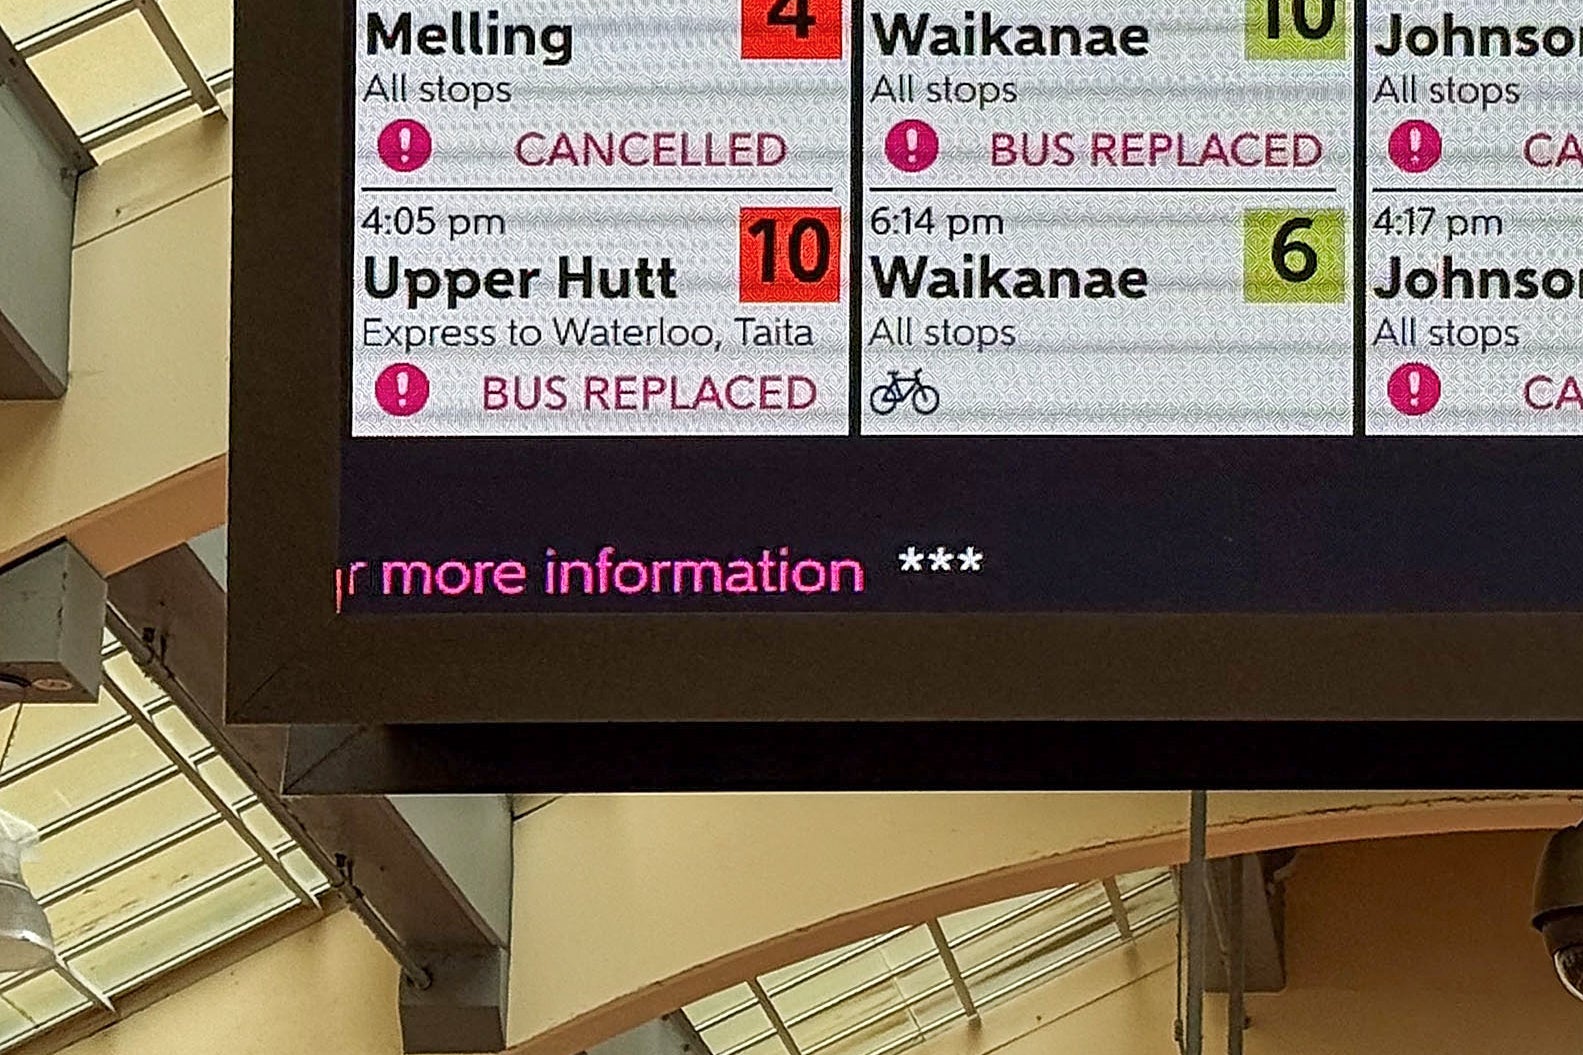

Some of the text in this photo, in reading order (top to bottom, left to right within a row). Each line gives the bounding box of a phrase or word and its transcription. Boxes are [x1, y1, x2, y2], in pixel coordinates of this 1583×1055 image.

[367, 10, 572, 65] Melling
[872, 11, 1148, 56] Waikanae
[363, 73, 511, 110] All stops
[870, 74, 1017, 110] All stops
[1373, 74, 1520, 111] All stops
[515, 132, 787, 166] CANCELLED
[992, 132, 1322, 167] BUS REPLACED
[362, 207, 505, 241] 4:05 pm
[871, 207, 1003, 241] 6:14 pm
[1373, 207, 1502, 241] 4:17 pm
[750, 218, 829, 282] 10
[1272, 218, 1317, 282] 6
[365, 256, 676, 309] Upper Hutt
[870, 254, 1148, 299] Waikanae
[364, 317, 814, 354] Express to Waterloo, Taita
[868, 317, 1015, 353] All stops
[1372, 317, 1519, 354] All stops
[484, 375, 816, 410] BUS REPLACED
[382, 561, 527, 595] more
[544, 548, 864, 597] information
